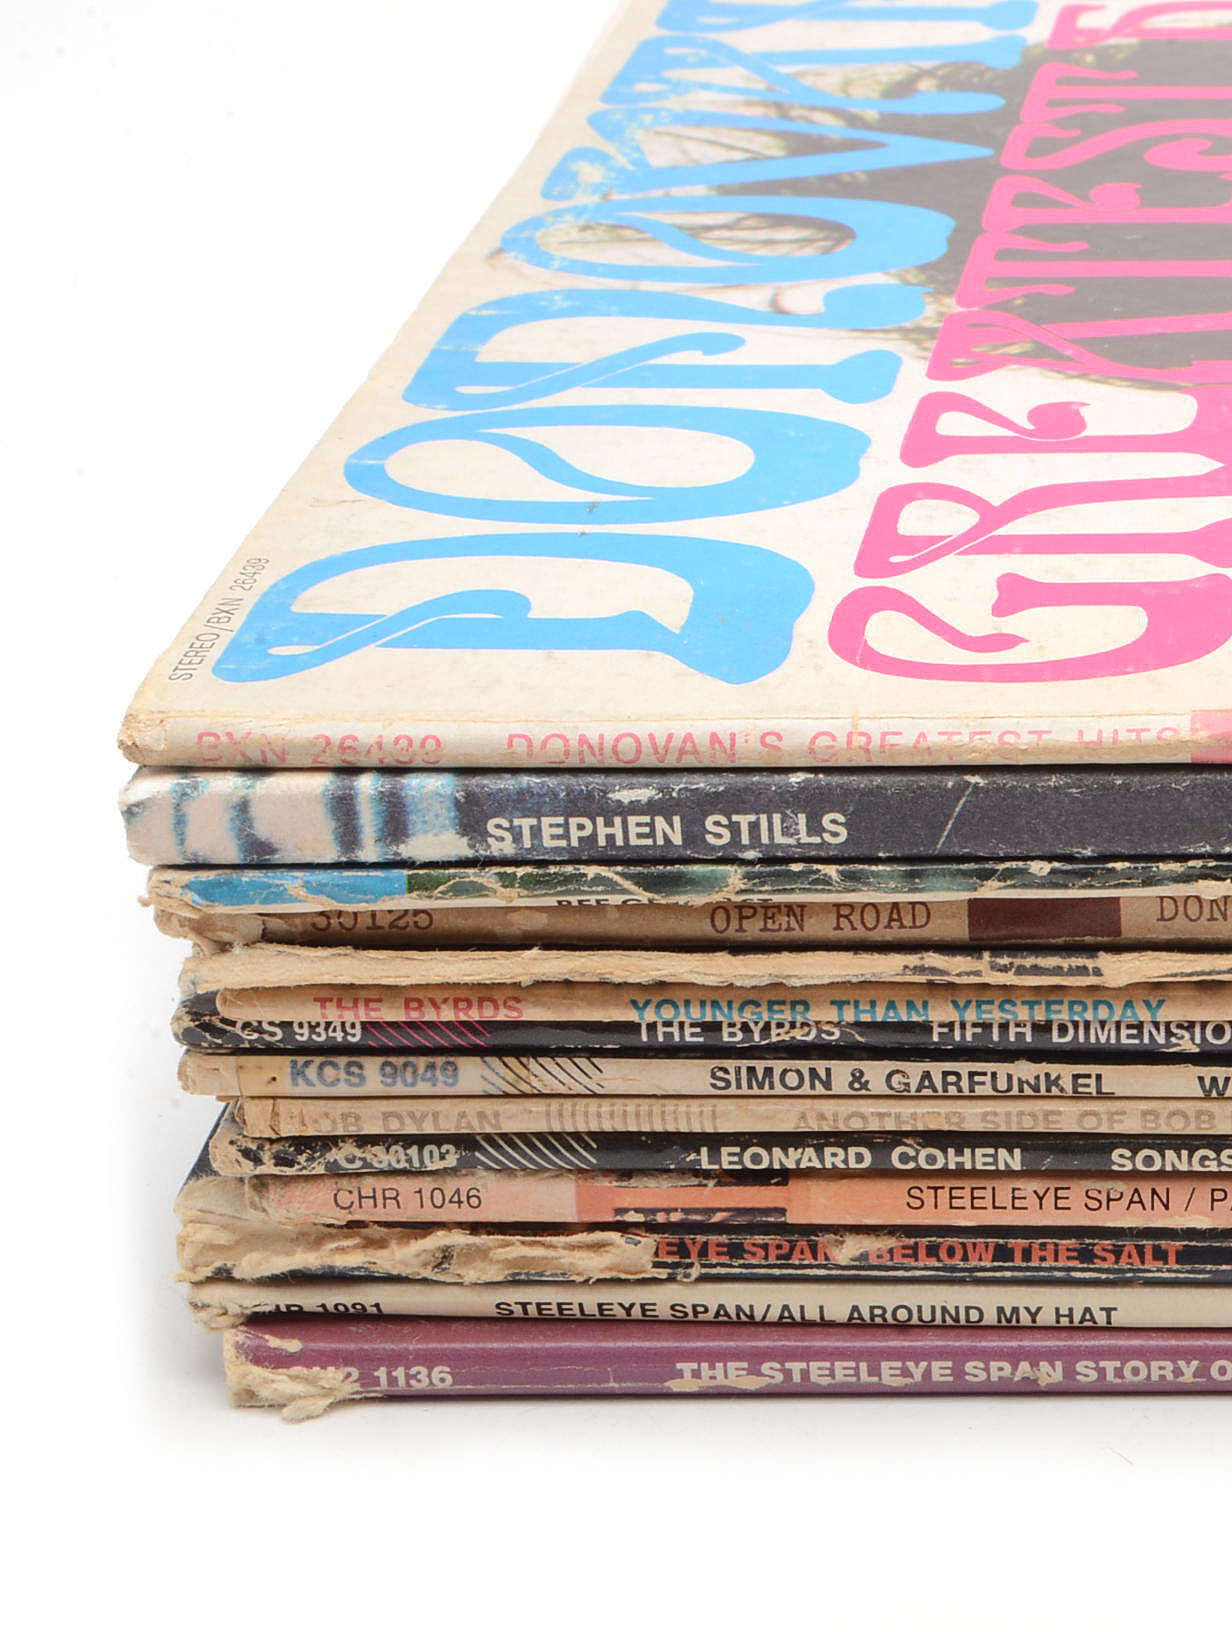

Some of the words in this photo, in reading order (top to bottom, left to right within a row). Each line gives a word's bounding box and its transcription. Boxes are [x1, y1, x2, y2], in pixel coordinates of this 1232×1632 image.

[486, 815, 683, 849] STEPHEN
[705, 812, 848, 847] STILLS
[710, 903, 808, 934] OPEN
[832, 901, 931, 932] ROAD
[313, 996, 385, 1021] THE
[404, 996, 524, 1021] BYRDS
[629, 998, 811, 1022] YOUNGER
[830, 998, 929, 1022] THAN
[950, 998, 1166, 1022] YESTERDAY
[293, 1020, 362, 1042] 9349
[639, 1021, 705, 1043] THE
[722, 1021, 841, 1043] BYRDS
[932, 1021, 1032, 1043] FIFTH
[289, 1059, 367, 1088] KCS
[379, 1060, 460, 1088] 9049
[710, 1066, 832, 1092] SIMON
[848, 1068, 871, 1092] &
[885, 1069, 1115, 1096] GARFUNKEL
[381, 1110, 501, 1133] DYLAN
[980, 1109, 1063, 1132] SIDE
[1077, 1109, 1128, 1132] OF
[1140, 1109, 1217, 1132] BOB
[699, 1146, 872, 1171] LEONARD
[890, 1146, 1022, 1171] COHEN
[333, 1187, 401, 1210] CHR
[413, 1186, 483, 1210] 1046
[905, 1185, 1072, 1211] STEELEYE
[1084, 1186, 1171, 1212] SPAN
[1008, 1241, 1080, 1265] THE
[1092, 1243, 1184, 1267] SALT
[495, 1302, 659, 1320] STEELEYE
[846, 1304, 985, 1326] AROUND
[996, 1306, 1044, 1326] MY
[1054, 1306, 1118, 1326] HAT
[374, 1365, 453, 1388] 1136
[676, 1361, 749, 1382] THE
[760, 1361, 954, 1384] STEELEYE
[965, 1361, 1064, 1384] SPAN
[1075, 1360, 1201, 1384] STORY
